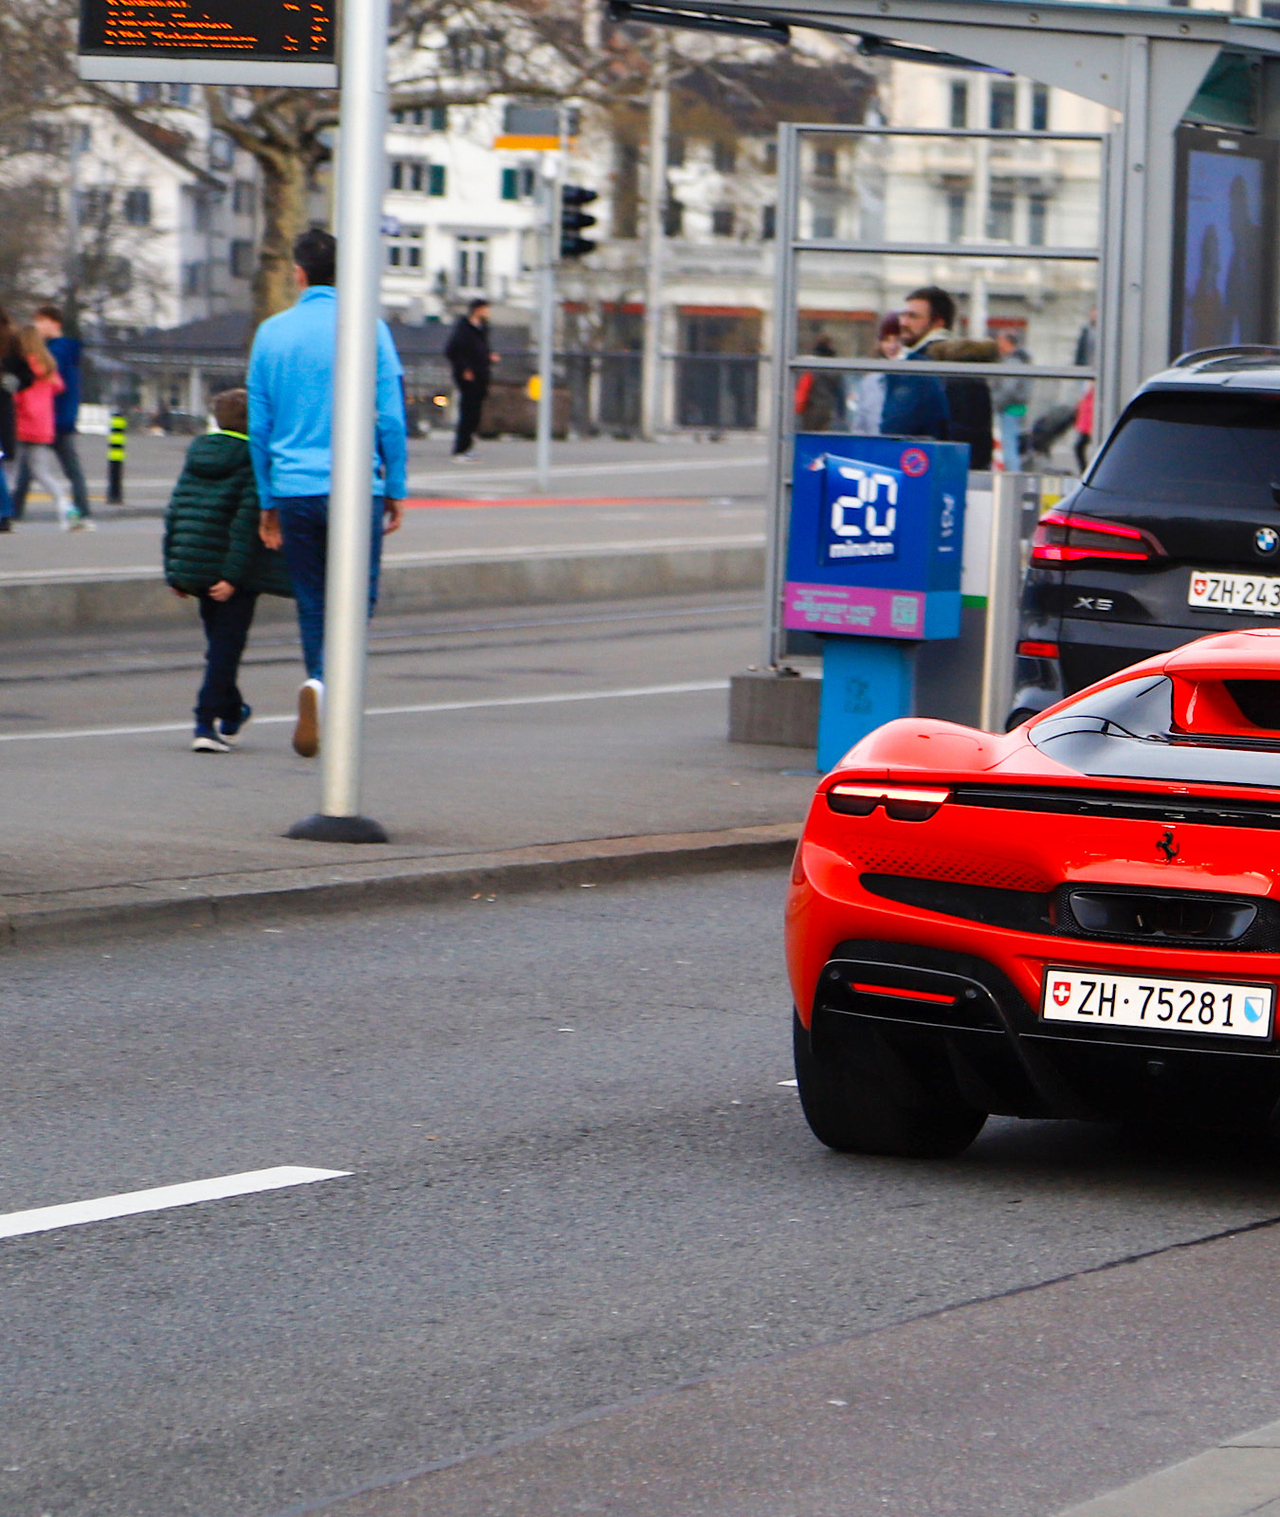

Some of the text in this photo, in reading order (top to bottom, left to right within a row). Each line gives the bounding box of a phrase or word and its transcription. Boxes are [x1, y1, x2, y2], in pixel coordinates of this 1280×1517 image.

[831, 466, 898, 537] 20
[829, 539, 895, 558] minuten
[1073, 597, 1114, 611] X5
